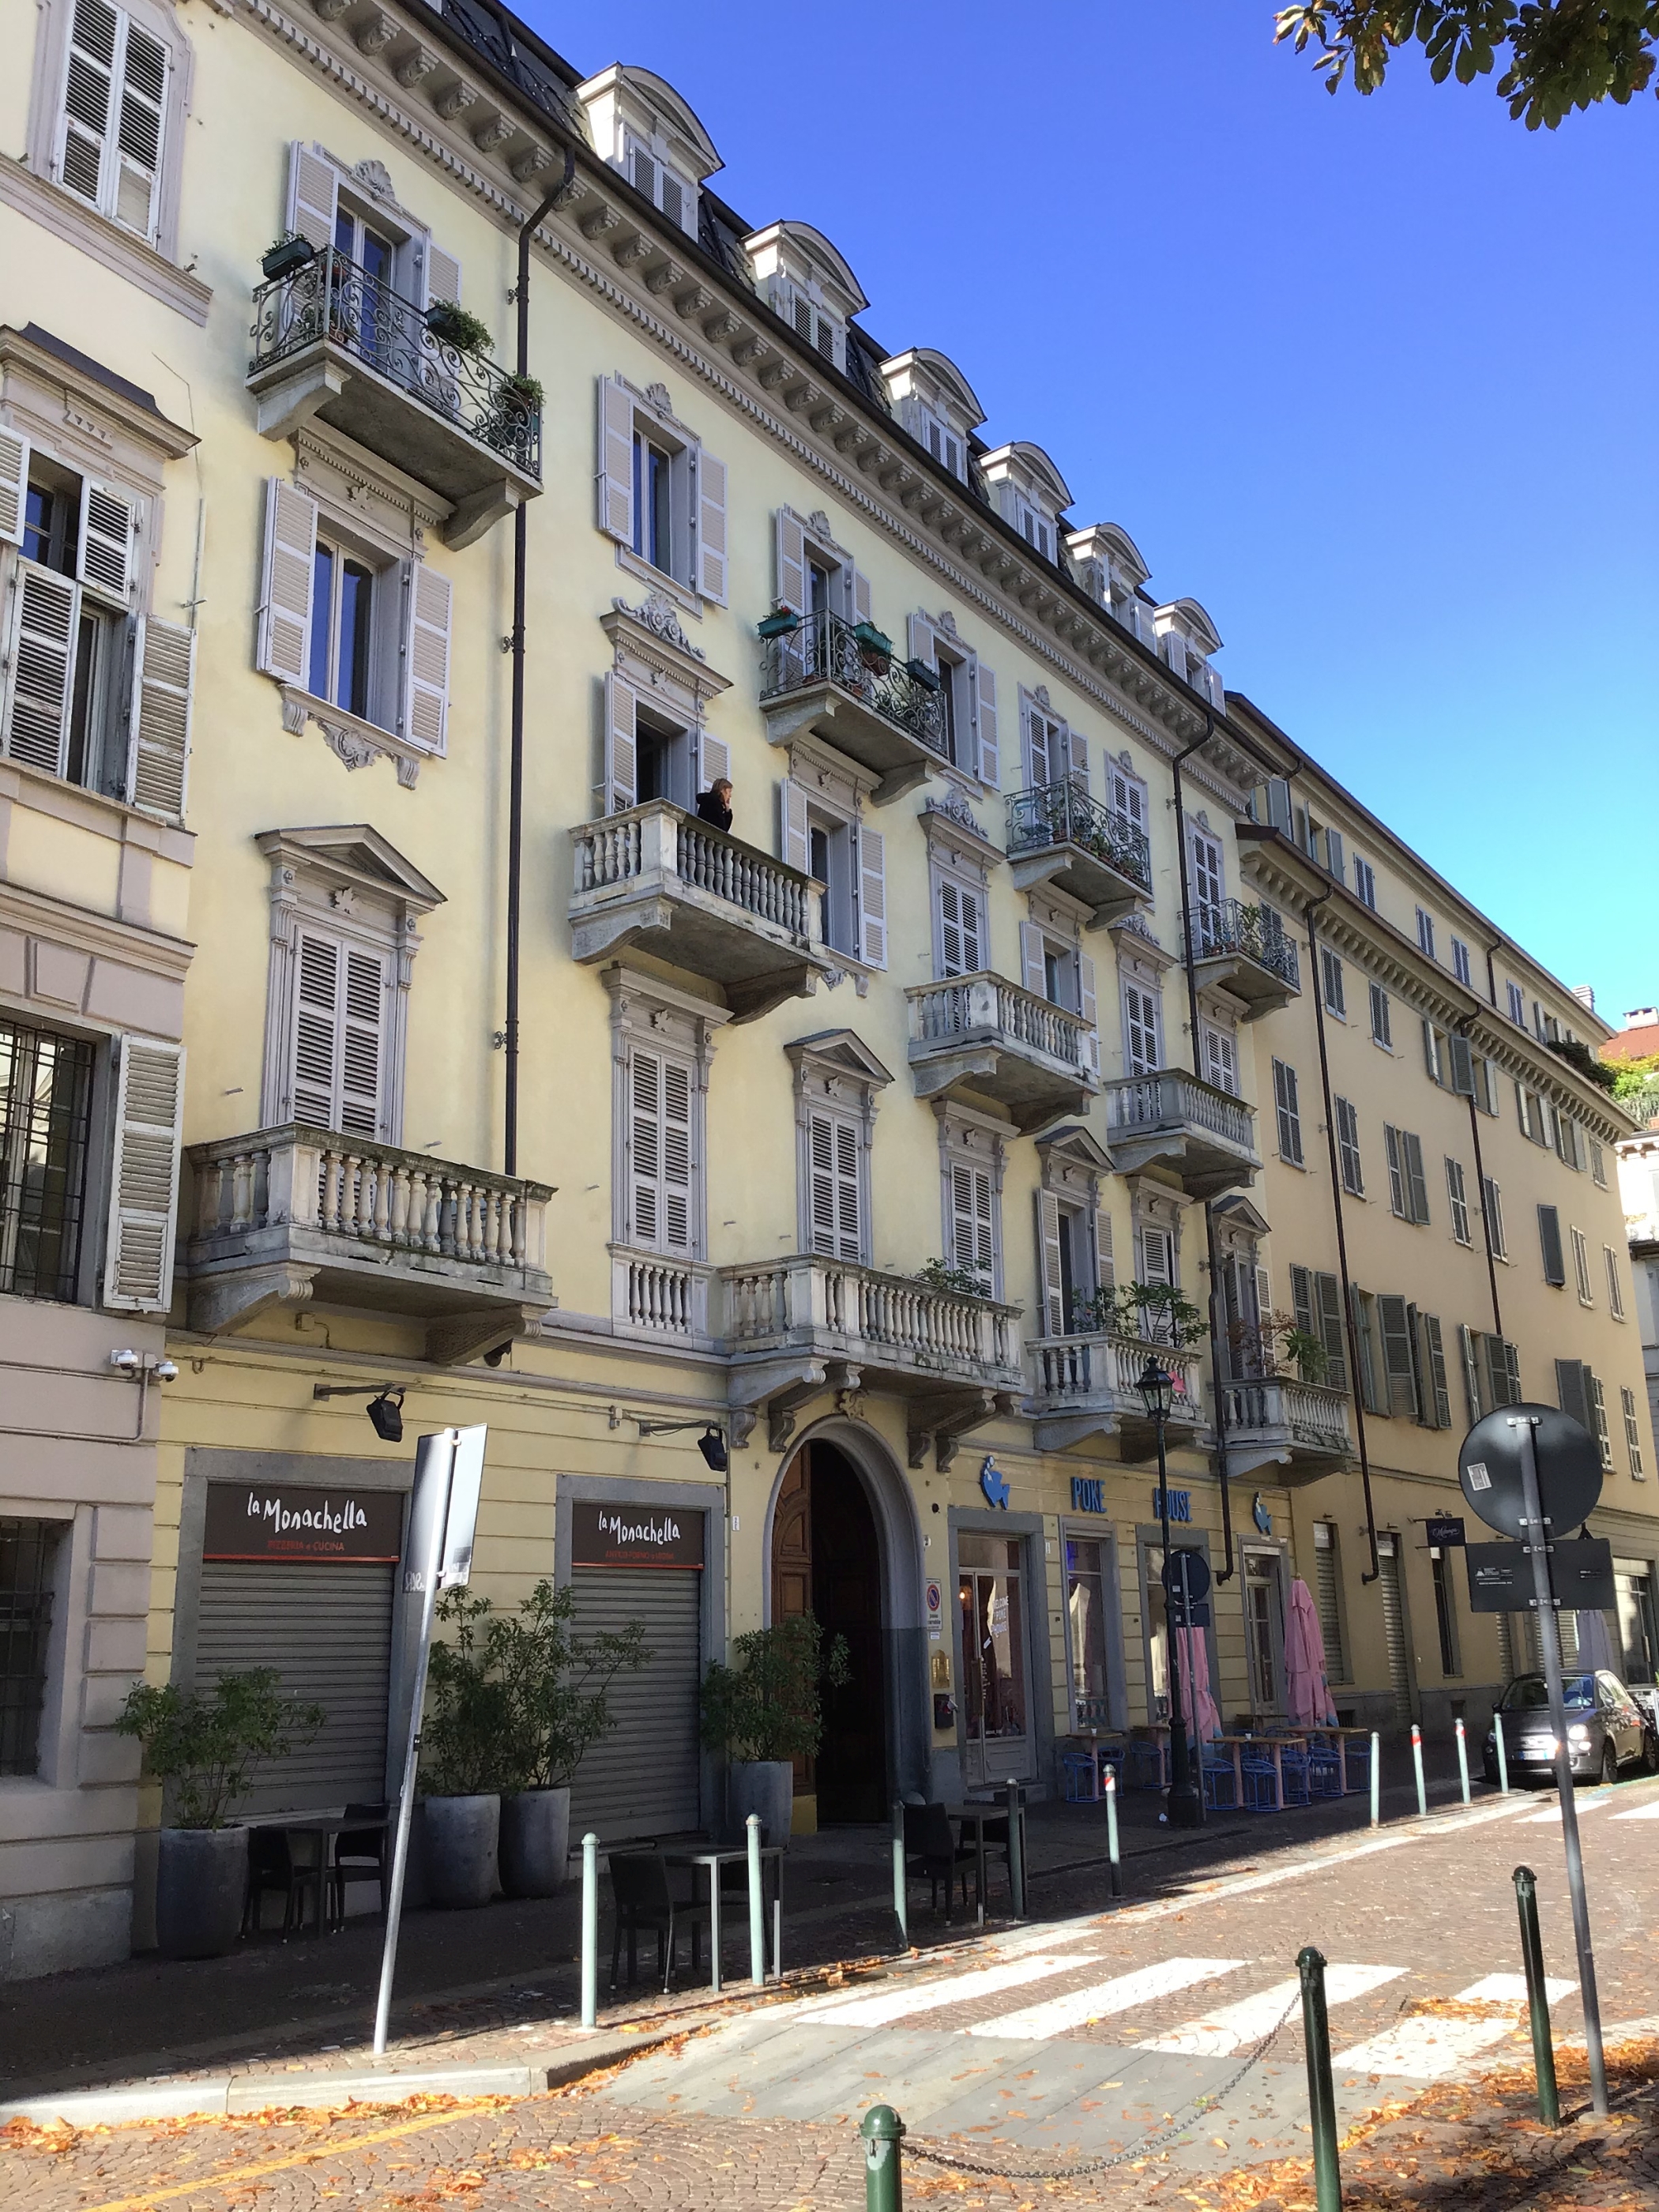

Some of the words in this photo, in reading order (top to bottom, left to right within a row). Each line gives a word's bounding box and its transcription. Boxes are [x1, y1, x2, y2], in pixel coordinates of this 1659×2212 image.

[247, 1492, 261, 1516] la
[262, 1498, 367, 1534] Monachella
[1070, 1476, 1107, 1514] POKE
[598, 1510, 608, 1531] la
[608, 1516, 681, 1545] Monachella
[313, 1541, 345, 1552] CUCINA
